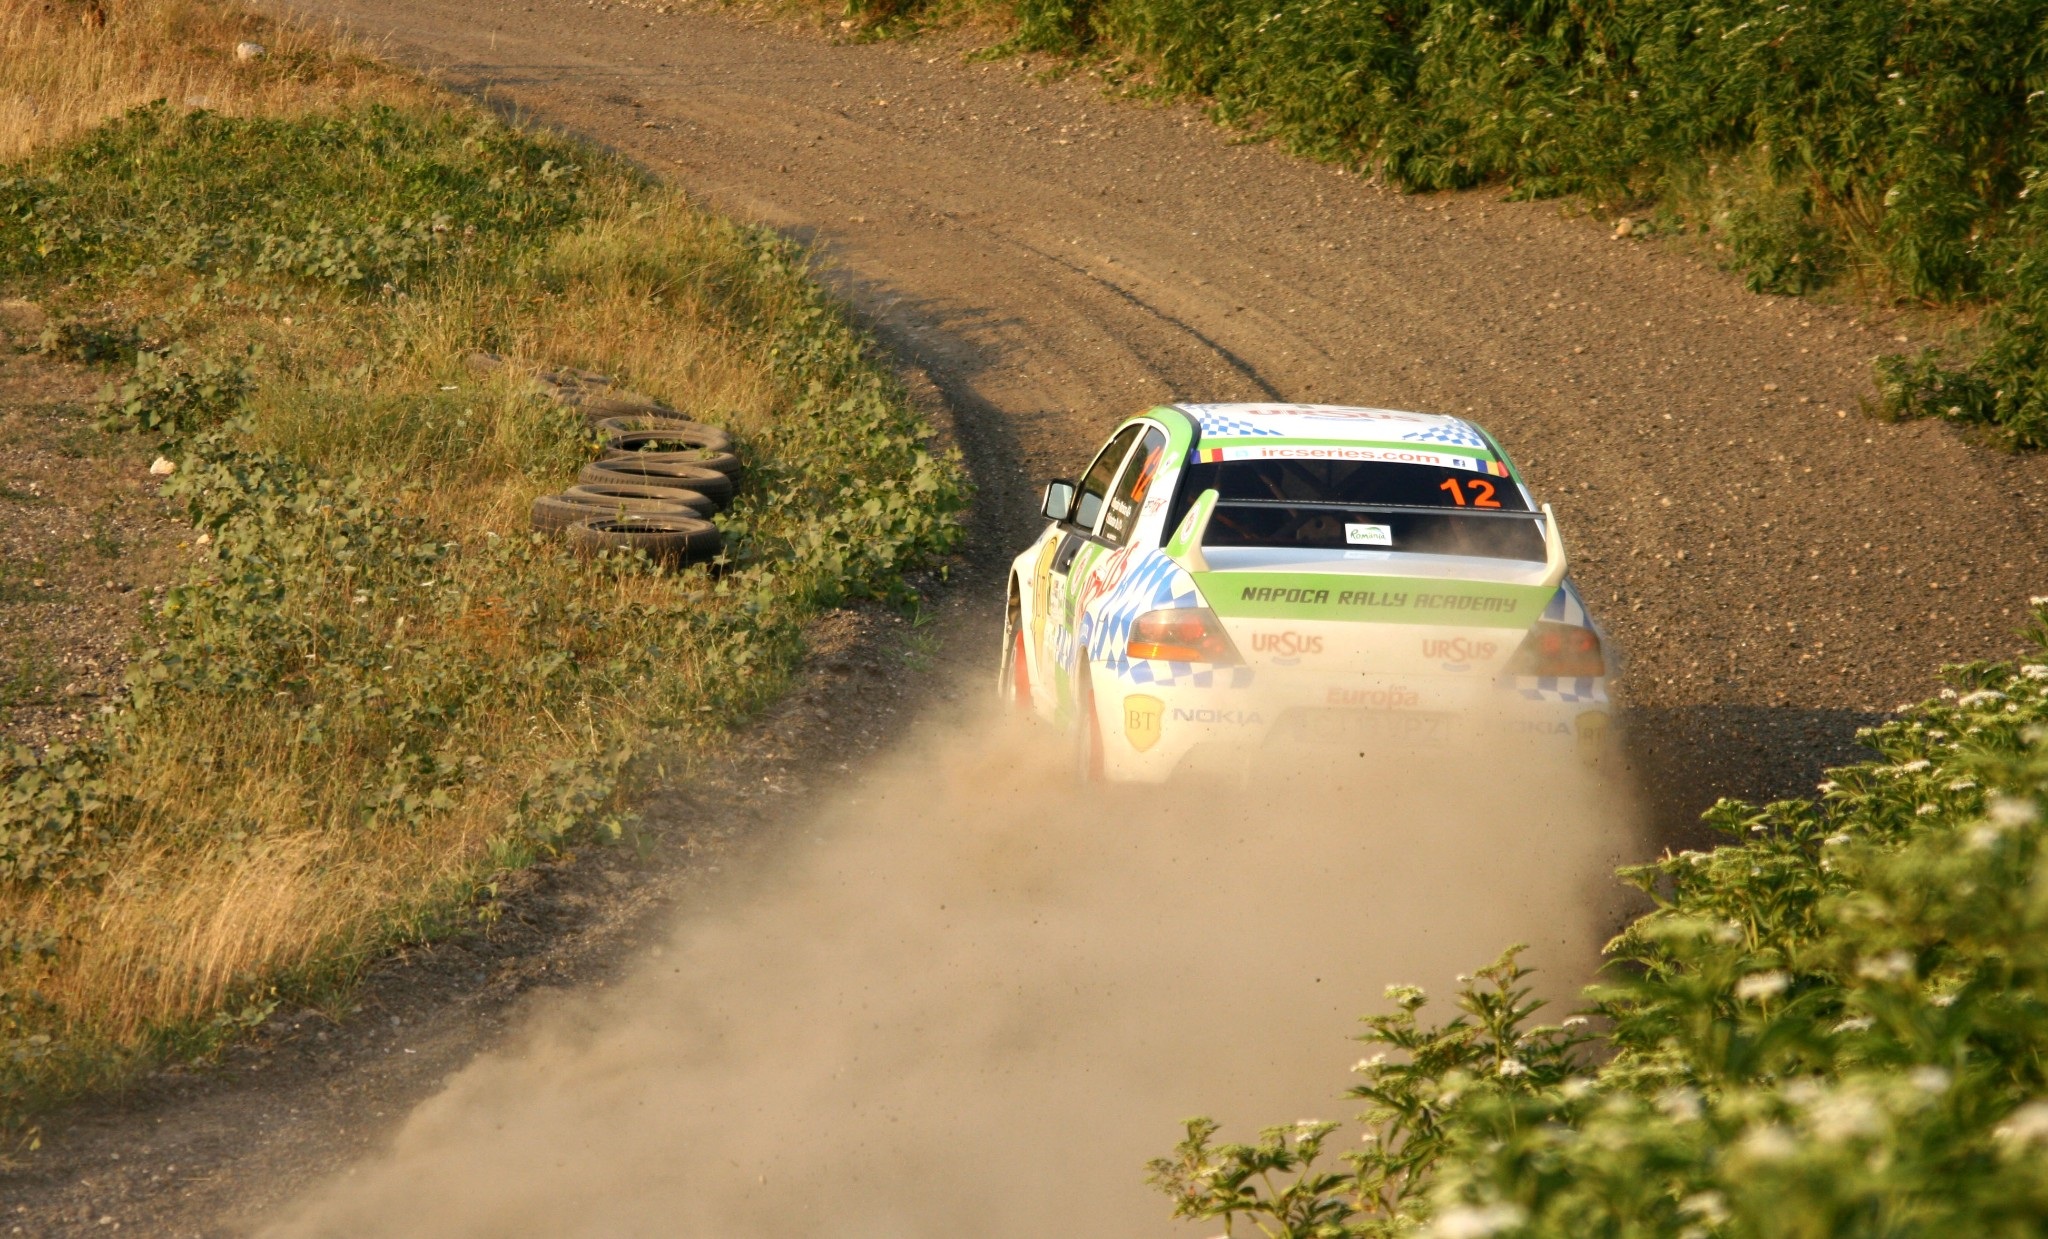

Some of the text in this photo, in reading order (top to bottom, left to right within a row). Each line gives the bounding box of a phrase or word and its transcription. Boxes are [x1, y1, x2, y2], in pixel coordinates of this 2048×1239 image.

[1261, 447, 1440, 464] ircseries.com
[1440, 478, 1502, 508] 12
[1241, 587, 1518, 613] NAPOCA RALLY ACADEMY
[1252, 631, 1324, 657] URSUS
[1129, 710, 1155, 731] BT
[1173, 708, 1264, 725] NOKIA
